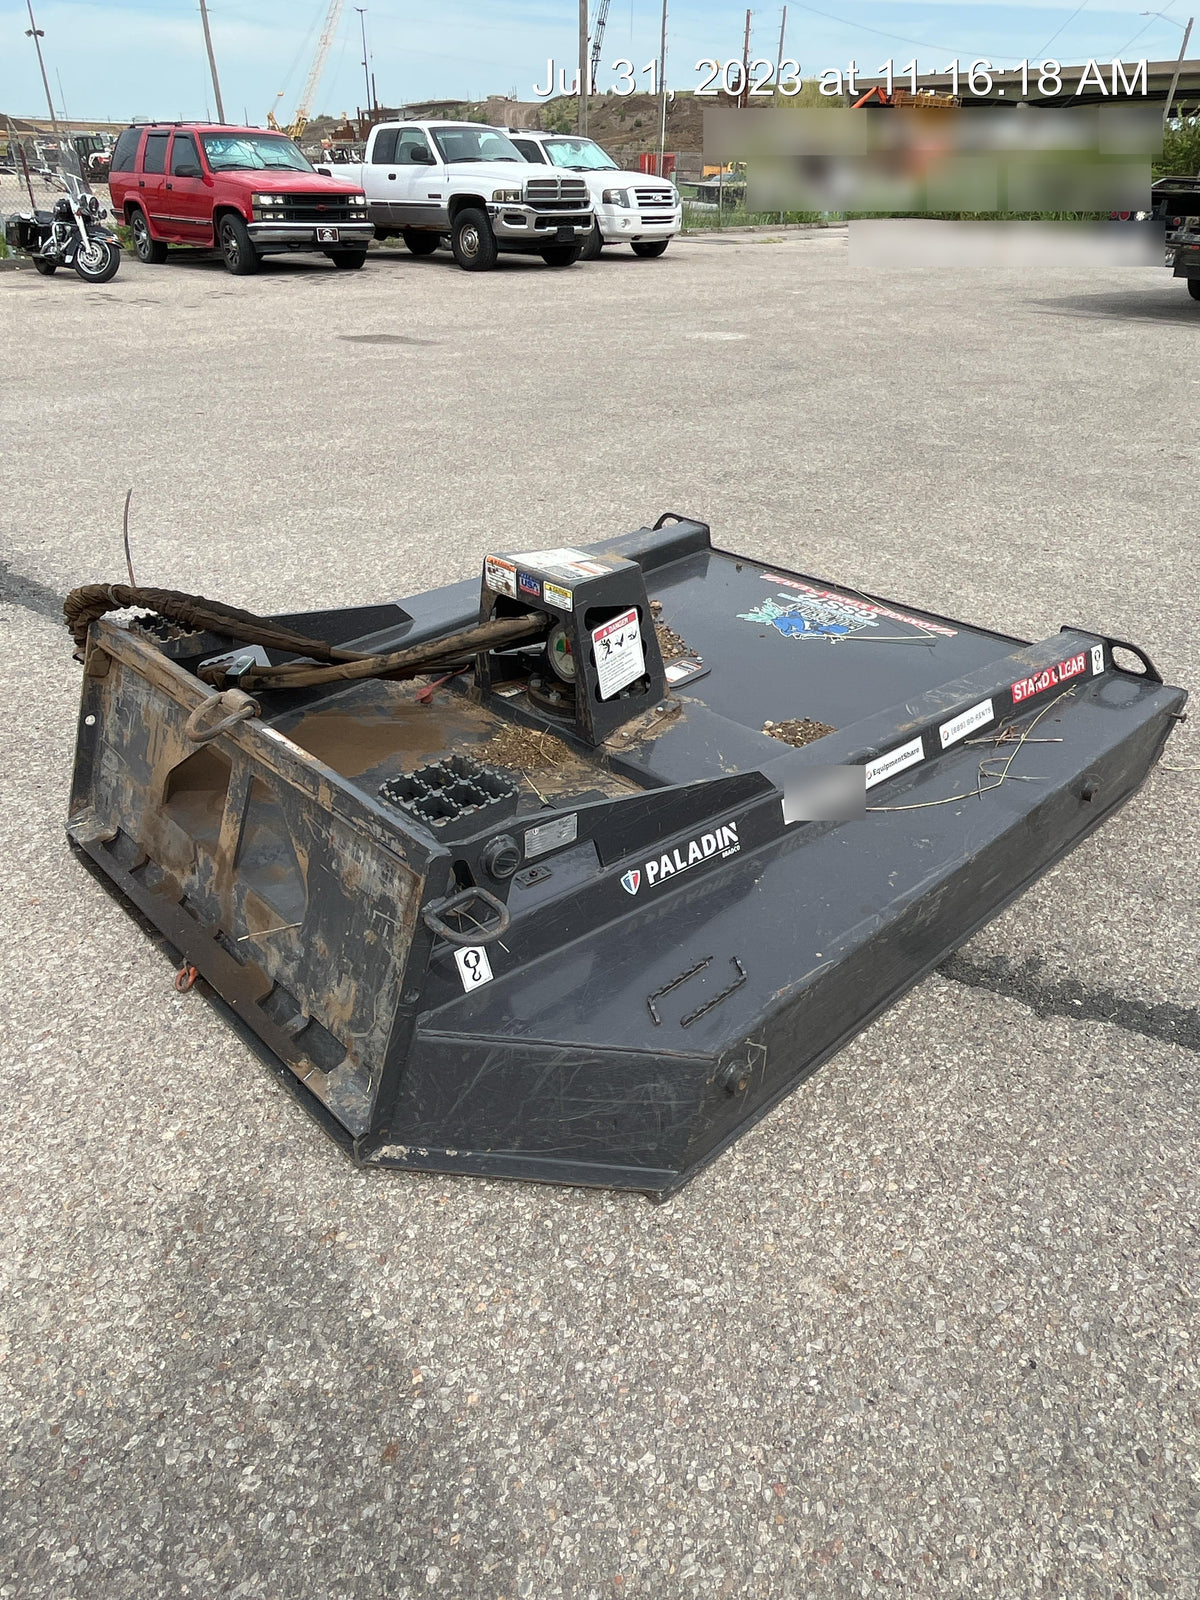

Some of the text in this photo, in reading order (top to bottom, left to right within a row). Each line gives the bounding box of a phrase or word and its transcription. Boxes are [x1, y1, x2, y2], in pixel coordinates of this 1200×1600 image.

[797, 594, 878, 620] GSS72
[1014, 671, 1051, 700] STAND
[872, 747, 920, 777] EquipmentShare
[645, 821, 739, 886] PALADIN
